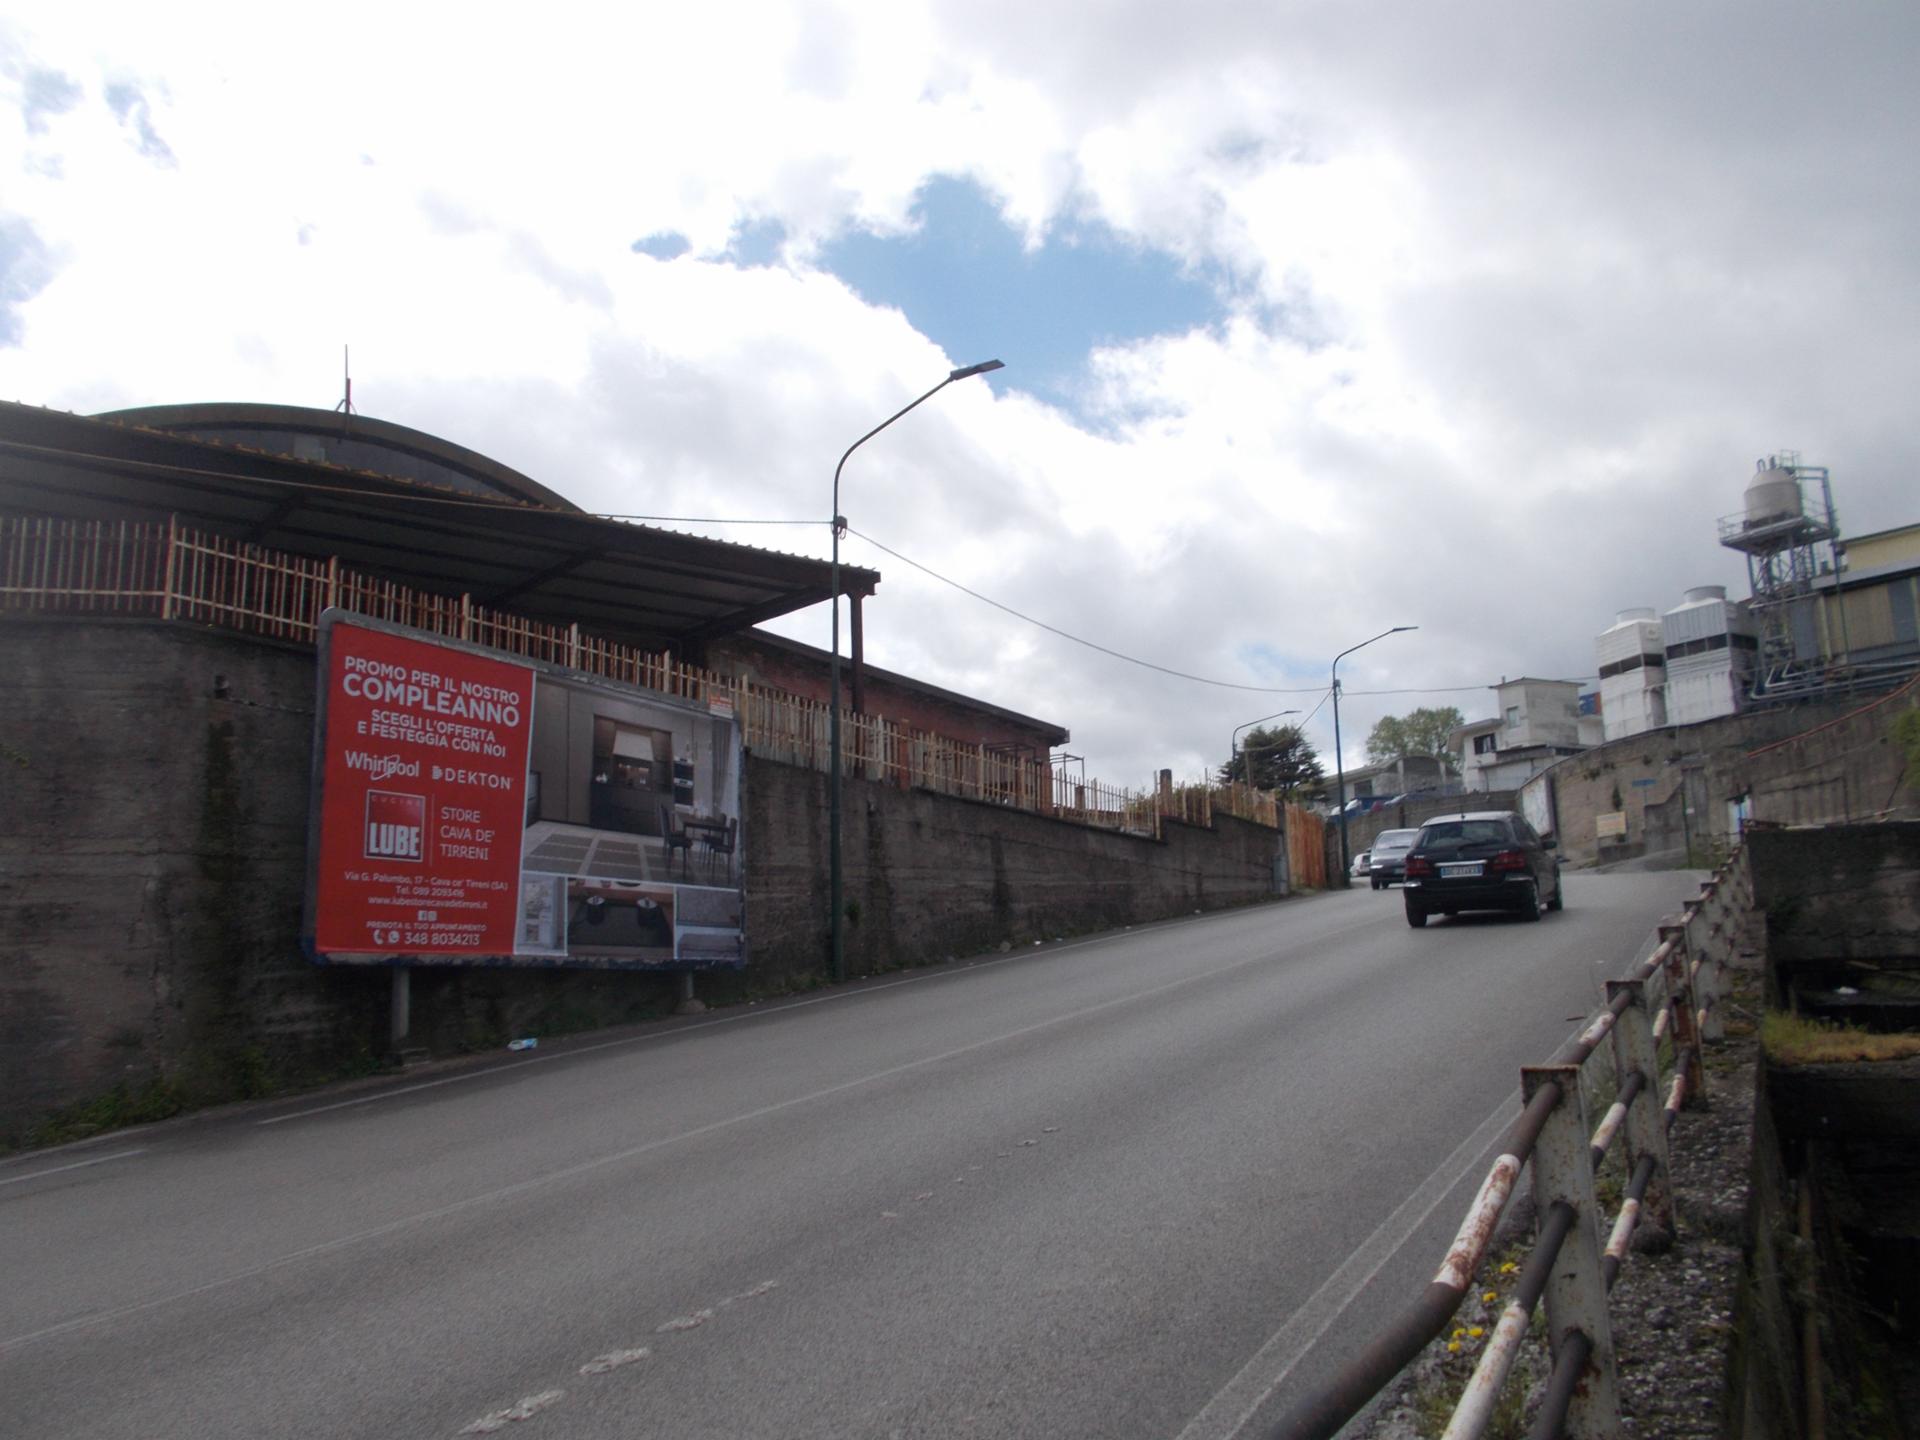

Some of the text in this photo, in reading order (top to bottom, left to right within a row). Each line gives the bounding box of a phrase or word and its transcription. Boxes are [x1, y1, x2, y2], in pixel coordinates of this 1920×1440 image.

[344, 656, 519, 705] PROMO PER IL NOSTRO
[343, 673, 519, 727] COMPLEANNO
[371, 709, 495, 742] SCEGLI L'OFFERTA
[357, 721, 505, 757] E FESTEGGIA CON NOI
[345, 750, 420, 781] Whirlpool
[445, 768, 511, 790] DEKTON
[441, 807, 481, 823] STORE
[369, 823, 420, 857] LUBE
[440, 826, 495, 842] CAVA DE'
[440, 844, 489, 860] TIRRENI
[344, 872, 359, 881] Via
[414, 876, 423, 884] 17
[430, 877, 451, 886] Cava
[466, 879, 490, 889] Tirreni
[366, 921, 403, 929] PRENOTA
[404, 933, 480, 946] 348 8034213
